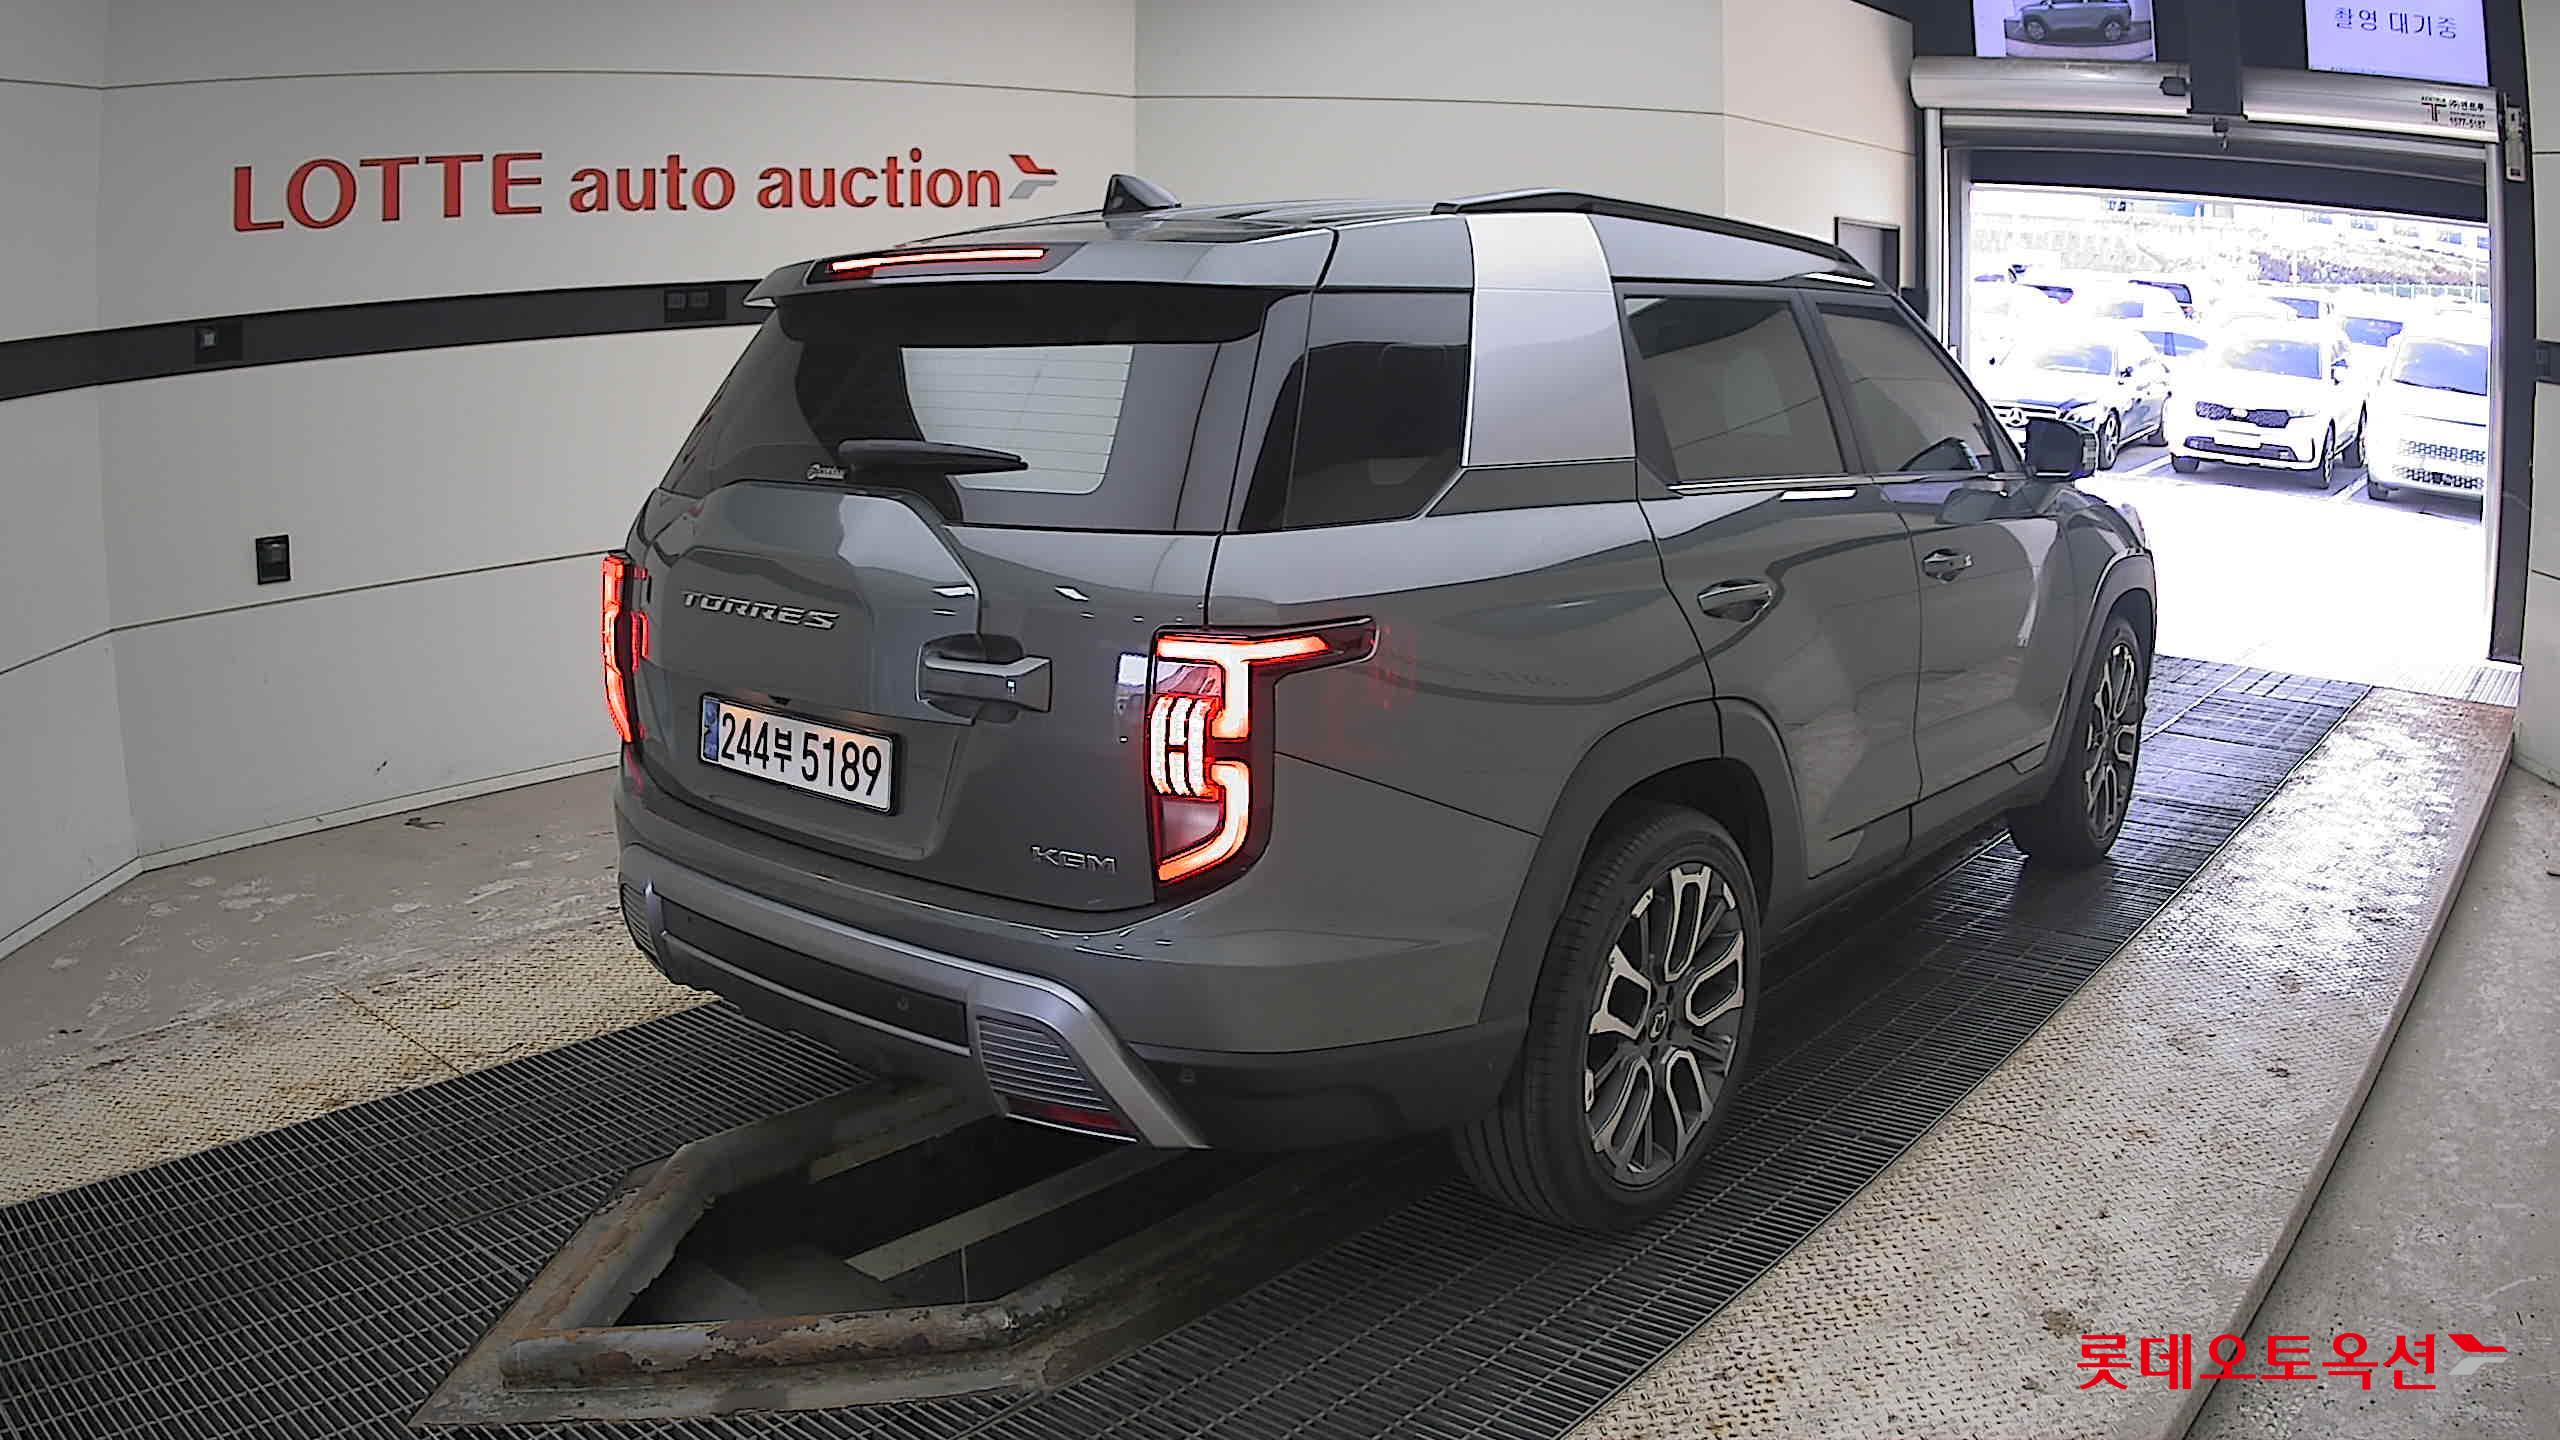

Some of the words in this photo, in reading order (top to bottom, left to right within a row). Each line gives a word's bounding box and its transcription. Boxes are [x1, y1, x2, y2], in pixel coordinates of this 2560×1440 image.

[2336, 8, 2377, 32] 촬영
[2389, 12, 2456, 40] 대기중
[234, 152, 541, 232] LOTTE
[569, 155, 736, 213] auto
[757, 148, 1001, 211] auction
[682, 590, 840, 629] TORRES
